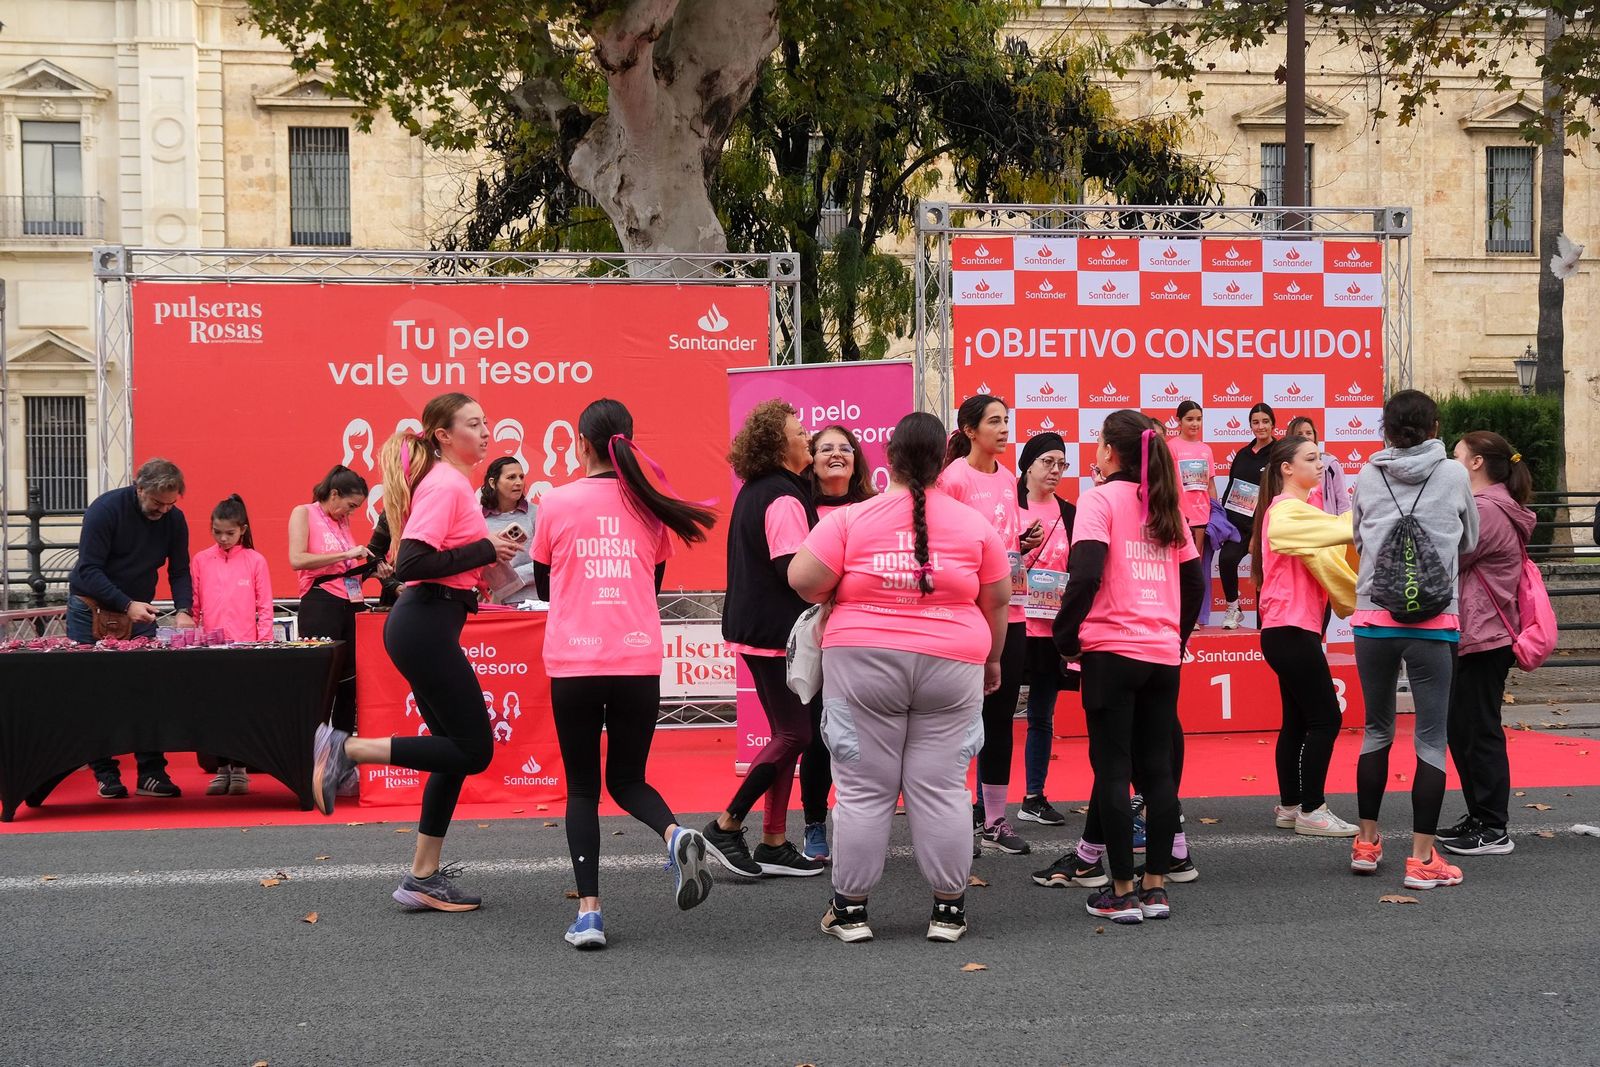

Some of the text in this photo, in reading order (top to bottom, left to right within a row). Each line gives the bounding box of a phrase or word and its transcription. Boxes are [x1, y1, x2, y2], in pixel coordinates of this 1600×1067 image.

[961, 256, 1003, 265] Santander
[1024, 256, 1066, 265] Santander
[1087, 257, 1128, 266] Santander
[1150, 258, 1190, 266] Santander
[1212, 259, 1253, 267] Santander
[1273, 259, 1312, 268] Santander
[1334, 260, 1373, 268] Santander
[961, 291, 1003, 299] Santander
[1025, 291, 1067, 299] Santander
[1088, 292, 1129, 300] Santander
[1150, 292, 1191, 300] Santander
[1213, 292, 1253, 300] Santander
[1273, 293, 1314, 301] Santander
[1334, 293, 1373, 302] Santander
[153, 296, 262, 324] pulseras
[189, 321, 263, 343] Rosas
[393, 318, 529, 357] Tu pelo
[669, 334, 757, 351] Santander
[964, 328, 1372, 366] ¡OBJETIVO CONSEGUIDO!
[328, 355, 593, 385] vale un tesoro
[1026, 394, 1068, 403] Santander
[1089, 394, 1130, 403] Santander
[1212, 394, 1253, 402] Santander
[1274, 394, 1314, 402] Santander
[1335, 393, 1374, 402] Santander
[811, 400, 861, 427] pelo
[1335, 428, 1375, 436] Santander
[596, 516, 620, 536] TU
[576, 537, 638, 559] DORSAL
[872, 552, 944, 572] DORSL
[584, 559, 632, 580] SUMA
[1131, 561, 1167, 581] SUMA
[598, 587, 620, 599] 2024
[675, 661, 736, 685] Rosa
[1210, 673, 1231, 720] 1
[385, 777, 420, 789] Rosas
[504, 775, 559, 786] Santander
